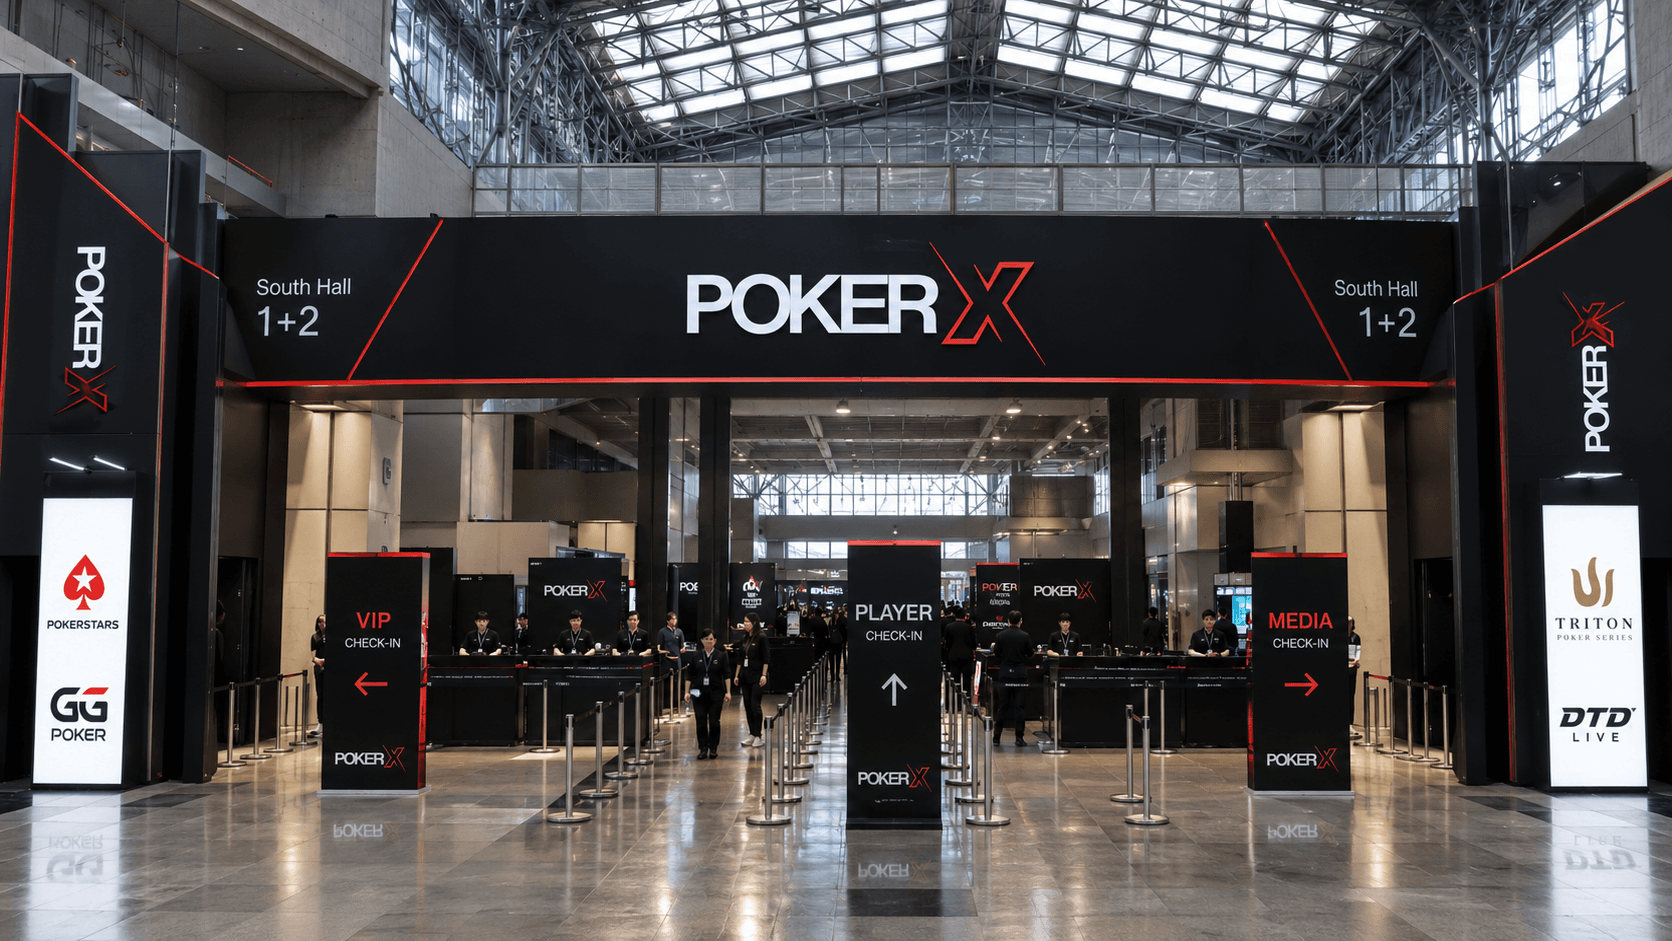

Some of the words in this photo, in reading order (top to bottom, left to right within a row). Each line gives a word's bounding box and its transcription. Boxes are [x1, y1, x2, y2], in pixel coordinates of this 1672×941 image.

[256, 278, 311, 296] South
[317, 278, 352, 295] Hall
[1334, 279, 1383, 297] South
[1387, 280, 1418, 298] Hall
[257, 305, 319, 337] 1+2
[1359, 306, 1417, 338] 1+2
[356, 611, 392, 630] VIP
[855, 603, 933, 622] PLAYER
[1268, 611, 1334, 630] MEDIA
[47, 619, 120, 630] POKERSTARS
[1555, 617, 1633, 630] TRITON
[344, 637, 401, 649] CHECK-IN
[865, 630, 923, 642] CHECK-IN
[1272, 637, 1329, 649] CHECK-IN
[50, 687, 109, 723] GG
[1559, 706, 1637, 728] DTD
[51, 727, 106, 742] POKER
[1572, 731, 1620, 743] LIVE
